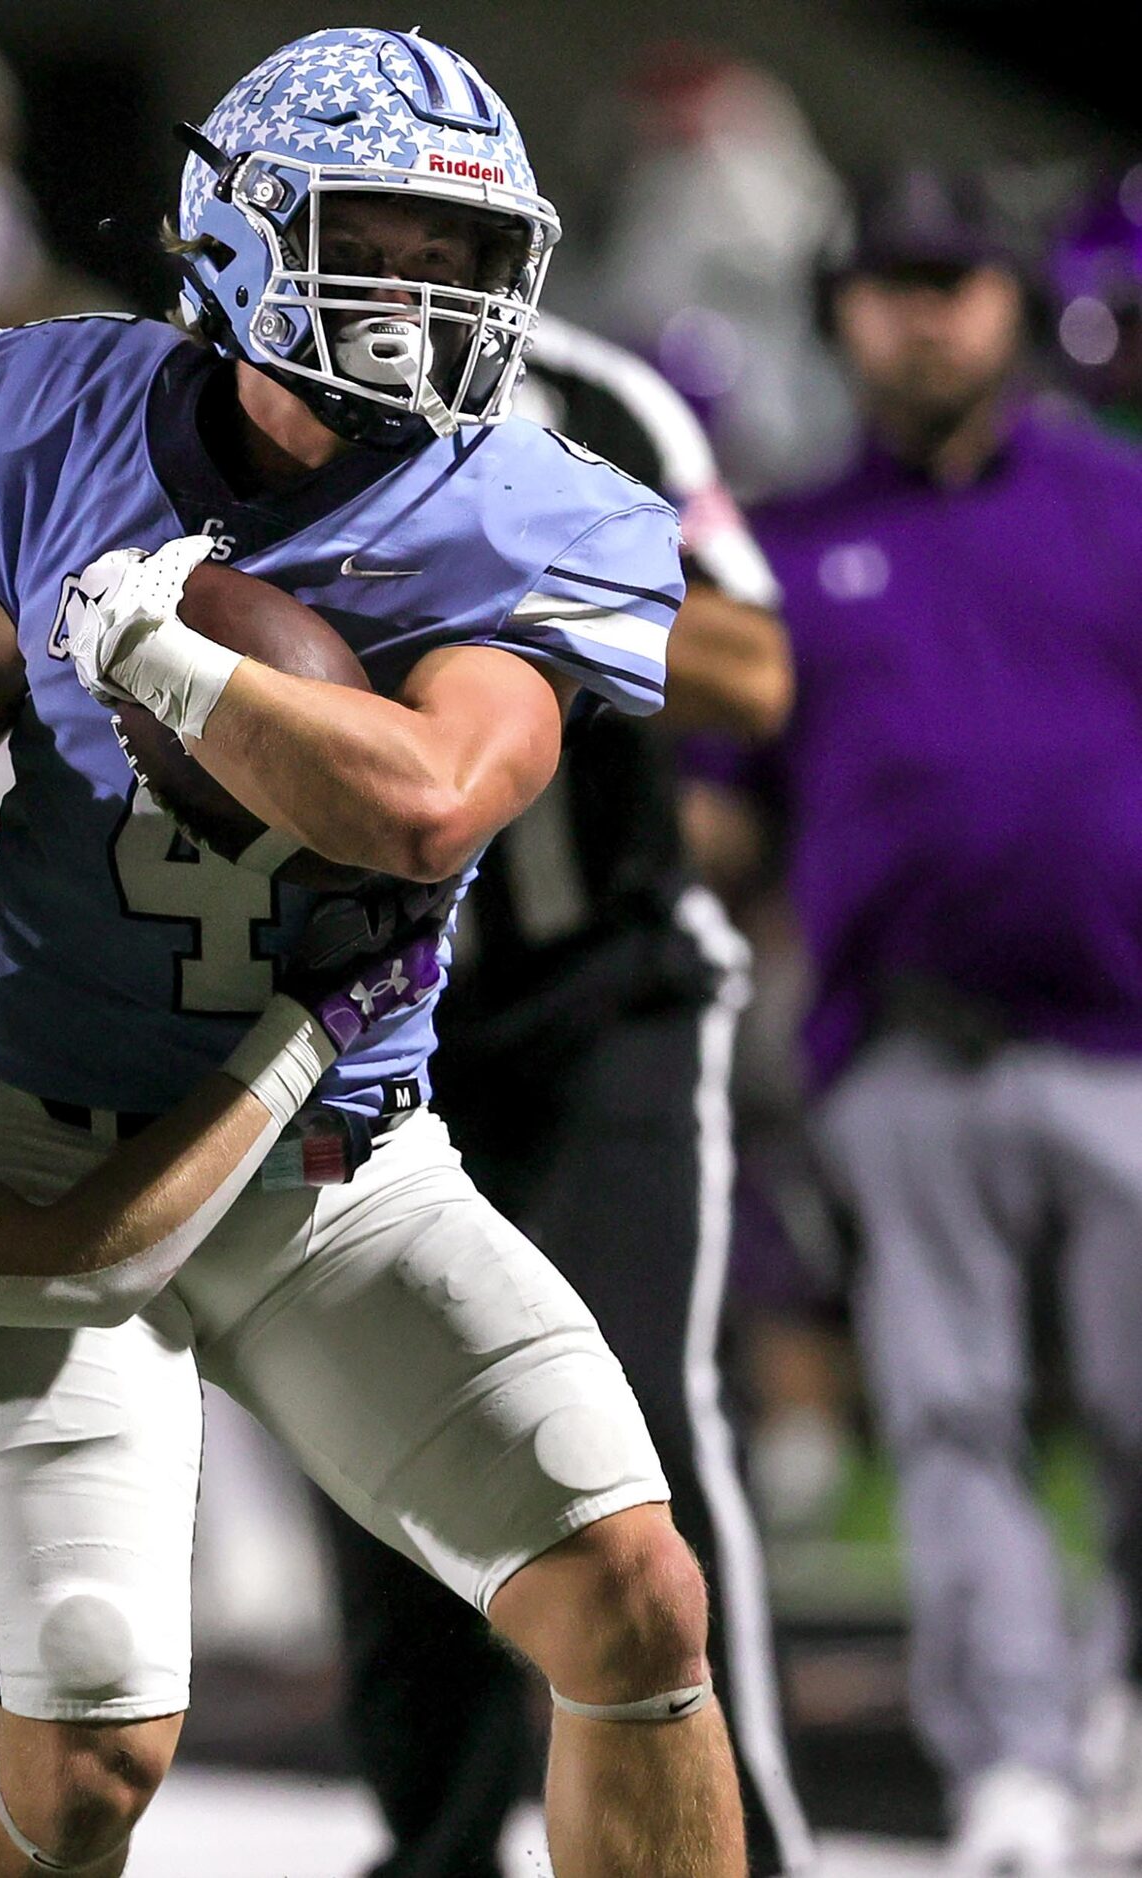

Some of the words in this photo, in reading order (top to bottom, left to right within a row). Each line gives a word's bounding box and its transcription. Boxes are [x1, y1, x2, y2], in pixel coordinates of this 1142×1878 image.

[249, 60, 295, 105] 4
[429, 153, 504, 184] Riddell
[109, 778, 298, 1018] 4
[395, 1087, 411, 1108] M
